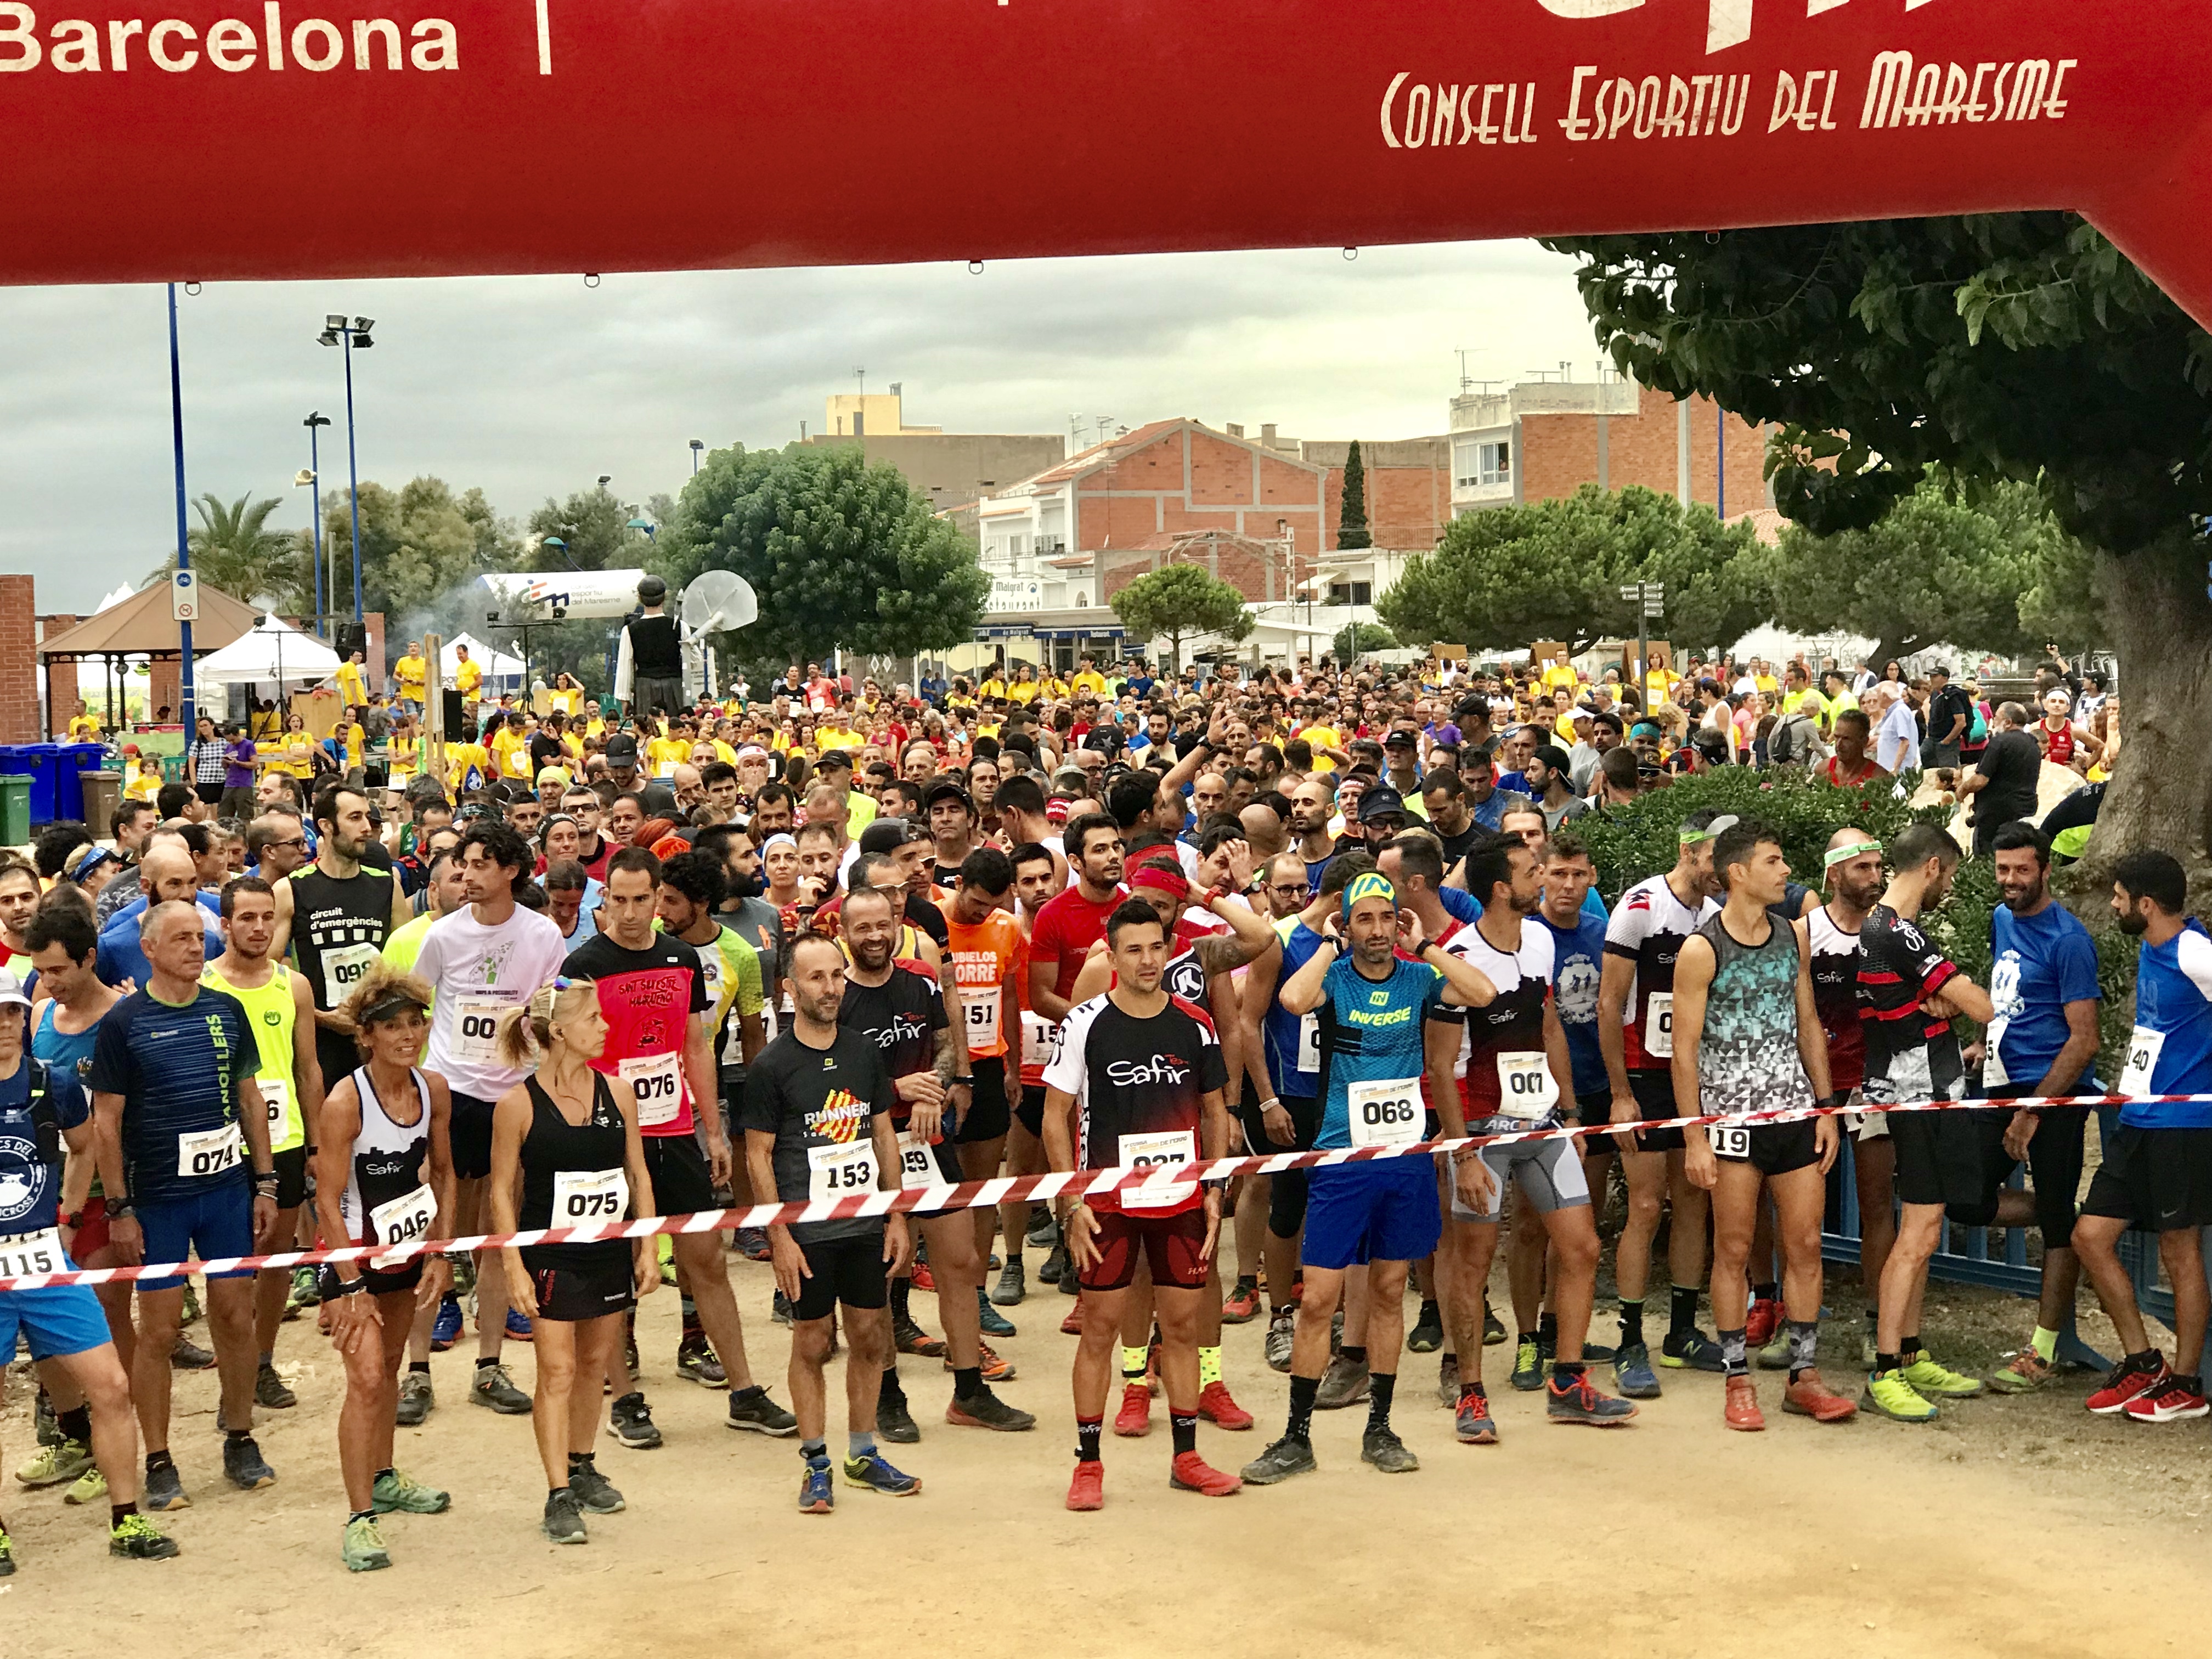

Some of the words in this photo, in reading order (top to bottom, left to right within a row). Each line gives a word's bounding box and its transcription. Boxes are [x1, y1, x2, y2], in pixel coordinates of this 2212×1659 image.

[0, 1, 460, 72] Barcelona
[996, 581, 1024, 596] Malgrat
[310, 907, 343, 920] circuit
[310, 916, 383, 930] d'emergències
[952, 951, 997, 963] UBIELOS
[955, 963, 997, 983] ORRE
[462, 1015, 495, 1039] 00
[1348, 1006, 1412, 1026] INVERSE
[1036, 1025, 1059, 1043] 15
[1107, 1054, 1190, 1086] Safir
[633, 1073, 675, 1100] 076
[804, 1102, 871, 1125] RUNNERS
[1363, 1099, 1414, 1125] 068
[13, 1141, 33, 1156] DEL
[193, 1144, 233, 1173] 074
[366, 1161, 404, 1175] Safir
[827, 1161, 870, 1188] 153
[0, 1195, 34, 1217] CROSS
[567, 1191, 618, 1216] 075
[388, 1210, 429, 1245] 046
